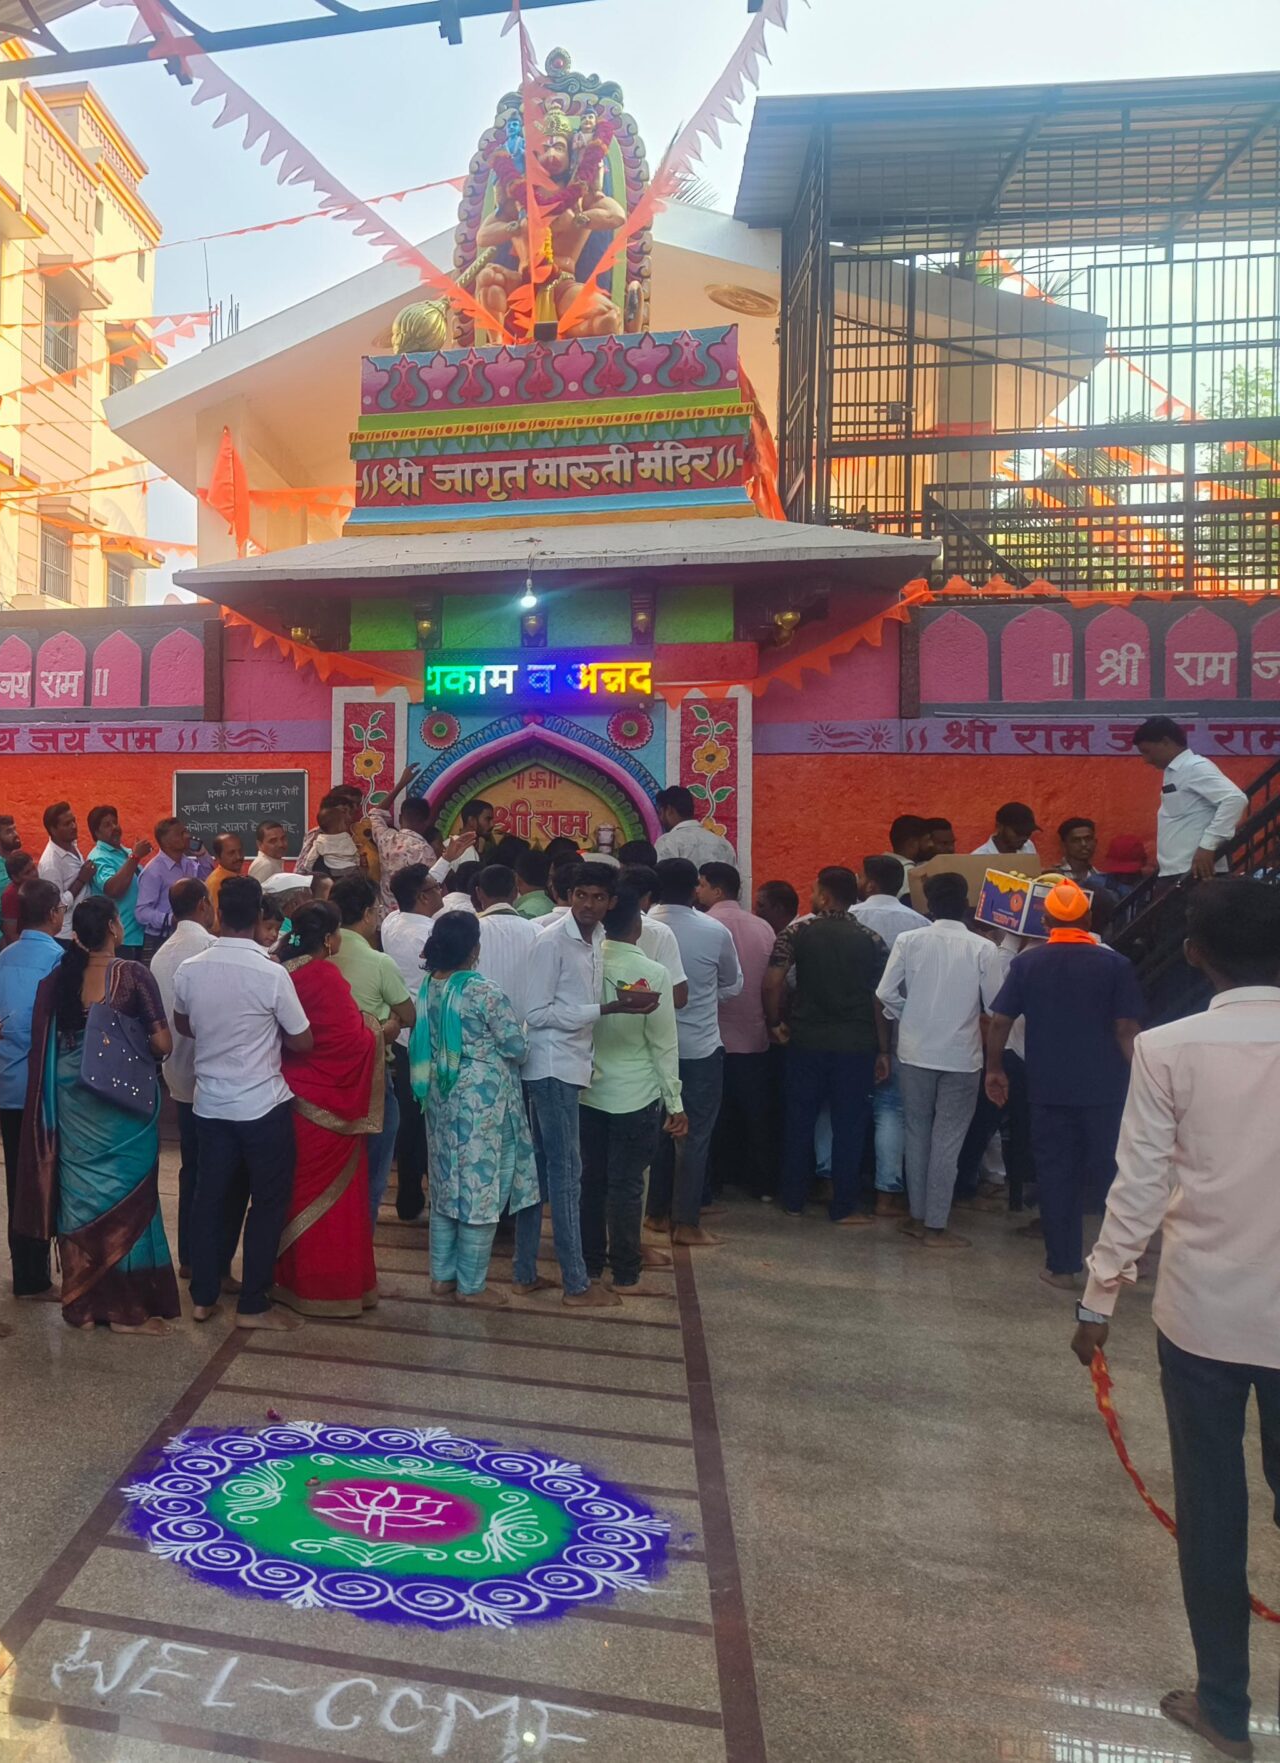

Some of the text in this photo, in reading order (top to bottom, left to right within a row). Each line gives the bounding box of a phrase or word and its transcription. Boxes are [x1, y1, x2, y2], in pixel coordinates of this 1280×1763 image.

[380, 458, 424, 498] श्री
[429, 458, 527, 502] जागृत
[637, 440, 715, 484] मंदिर
[527, 664, 557, 693] व
[1096, 642, 1145, 686] श्री
[1173, 651, 1238, 686] राम
[40, 669, 84, 698] राम
[27, 727, 90, 753] जय
[97, 726, 162, 752] राम
[942, 718, 997, 752] श्री
[1010, 724, 1094, 753] राम
[493, 798, 592, 840] श्री राम
